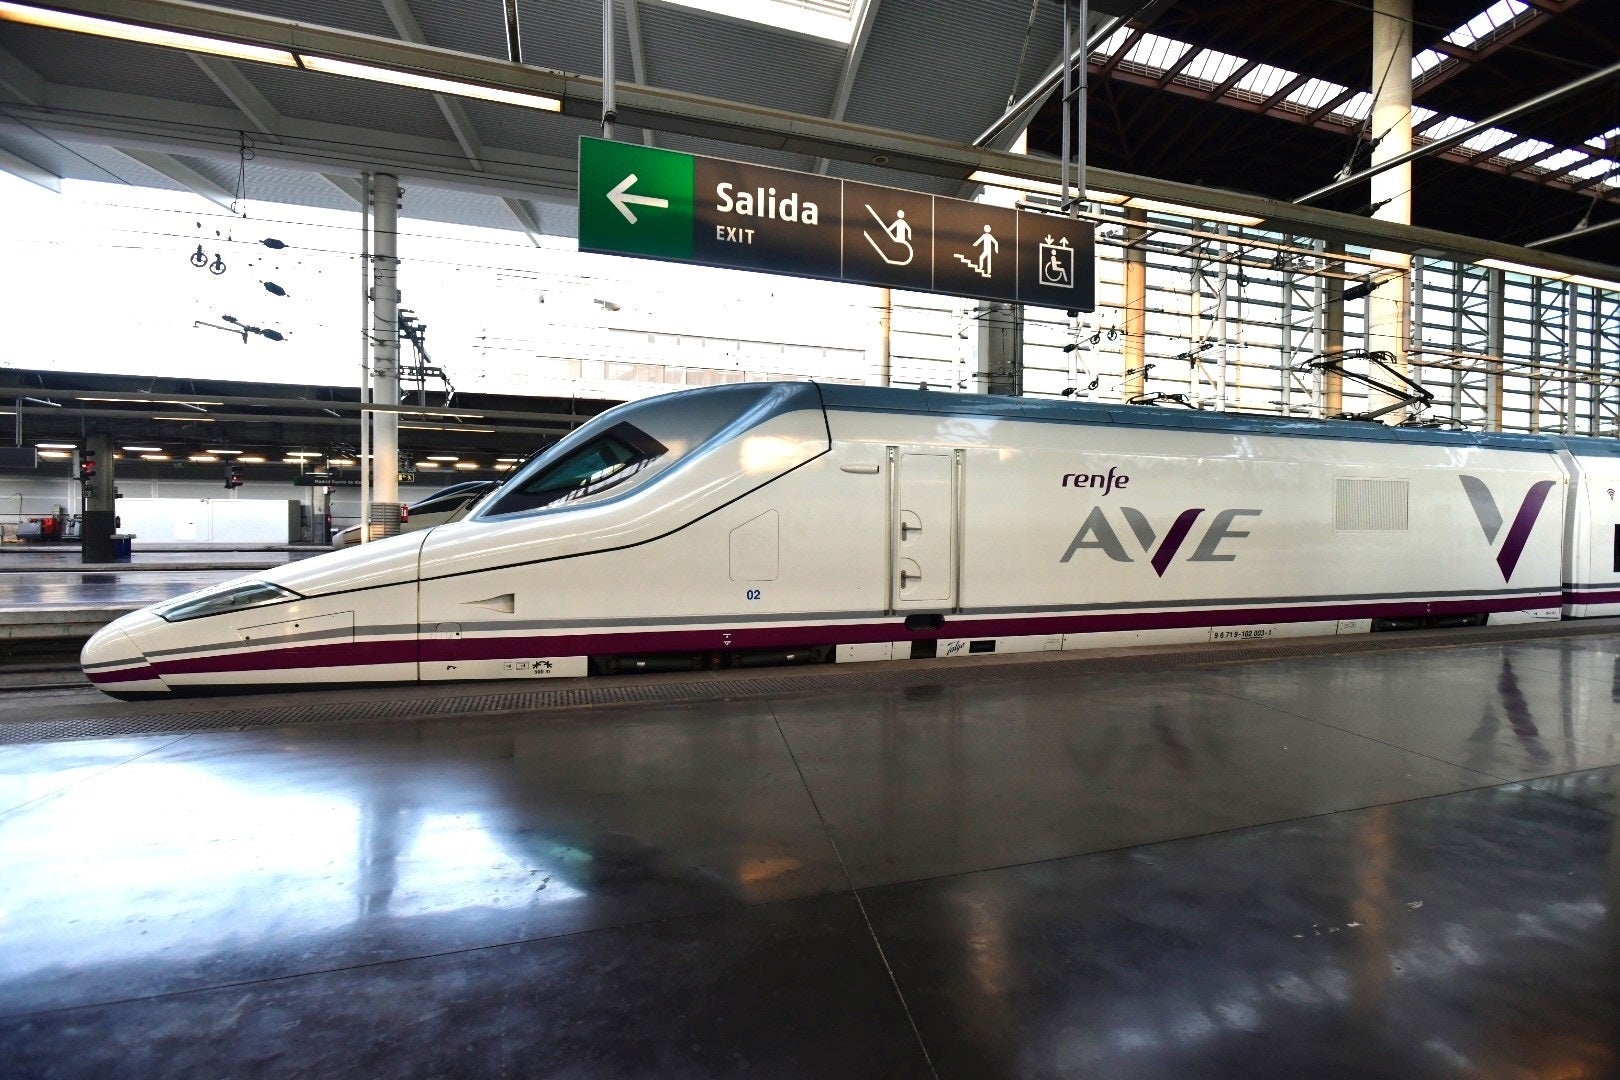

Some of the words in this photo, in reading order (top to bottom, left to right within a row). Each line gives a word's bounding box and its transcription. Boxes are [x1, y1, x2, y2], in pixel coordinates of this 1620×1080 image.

[716, 182, 819, 226] Salida
[716, 224, 755, 245] EXIT
[1061, 466, 1130, 497] renfe
[1059, 505, 1263, 578] AVE
[746, 589, 761, 601] 02
